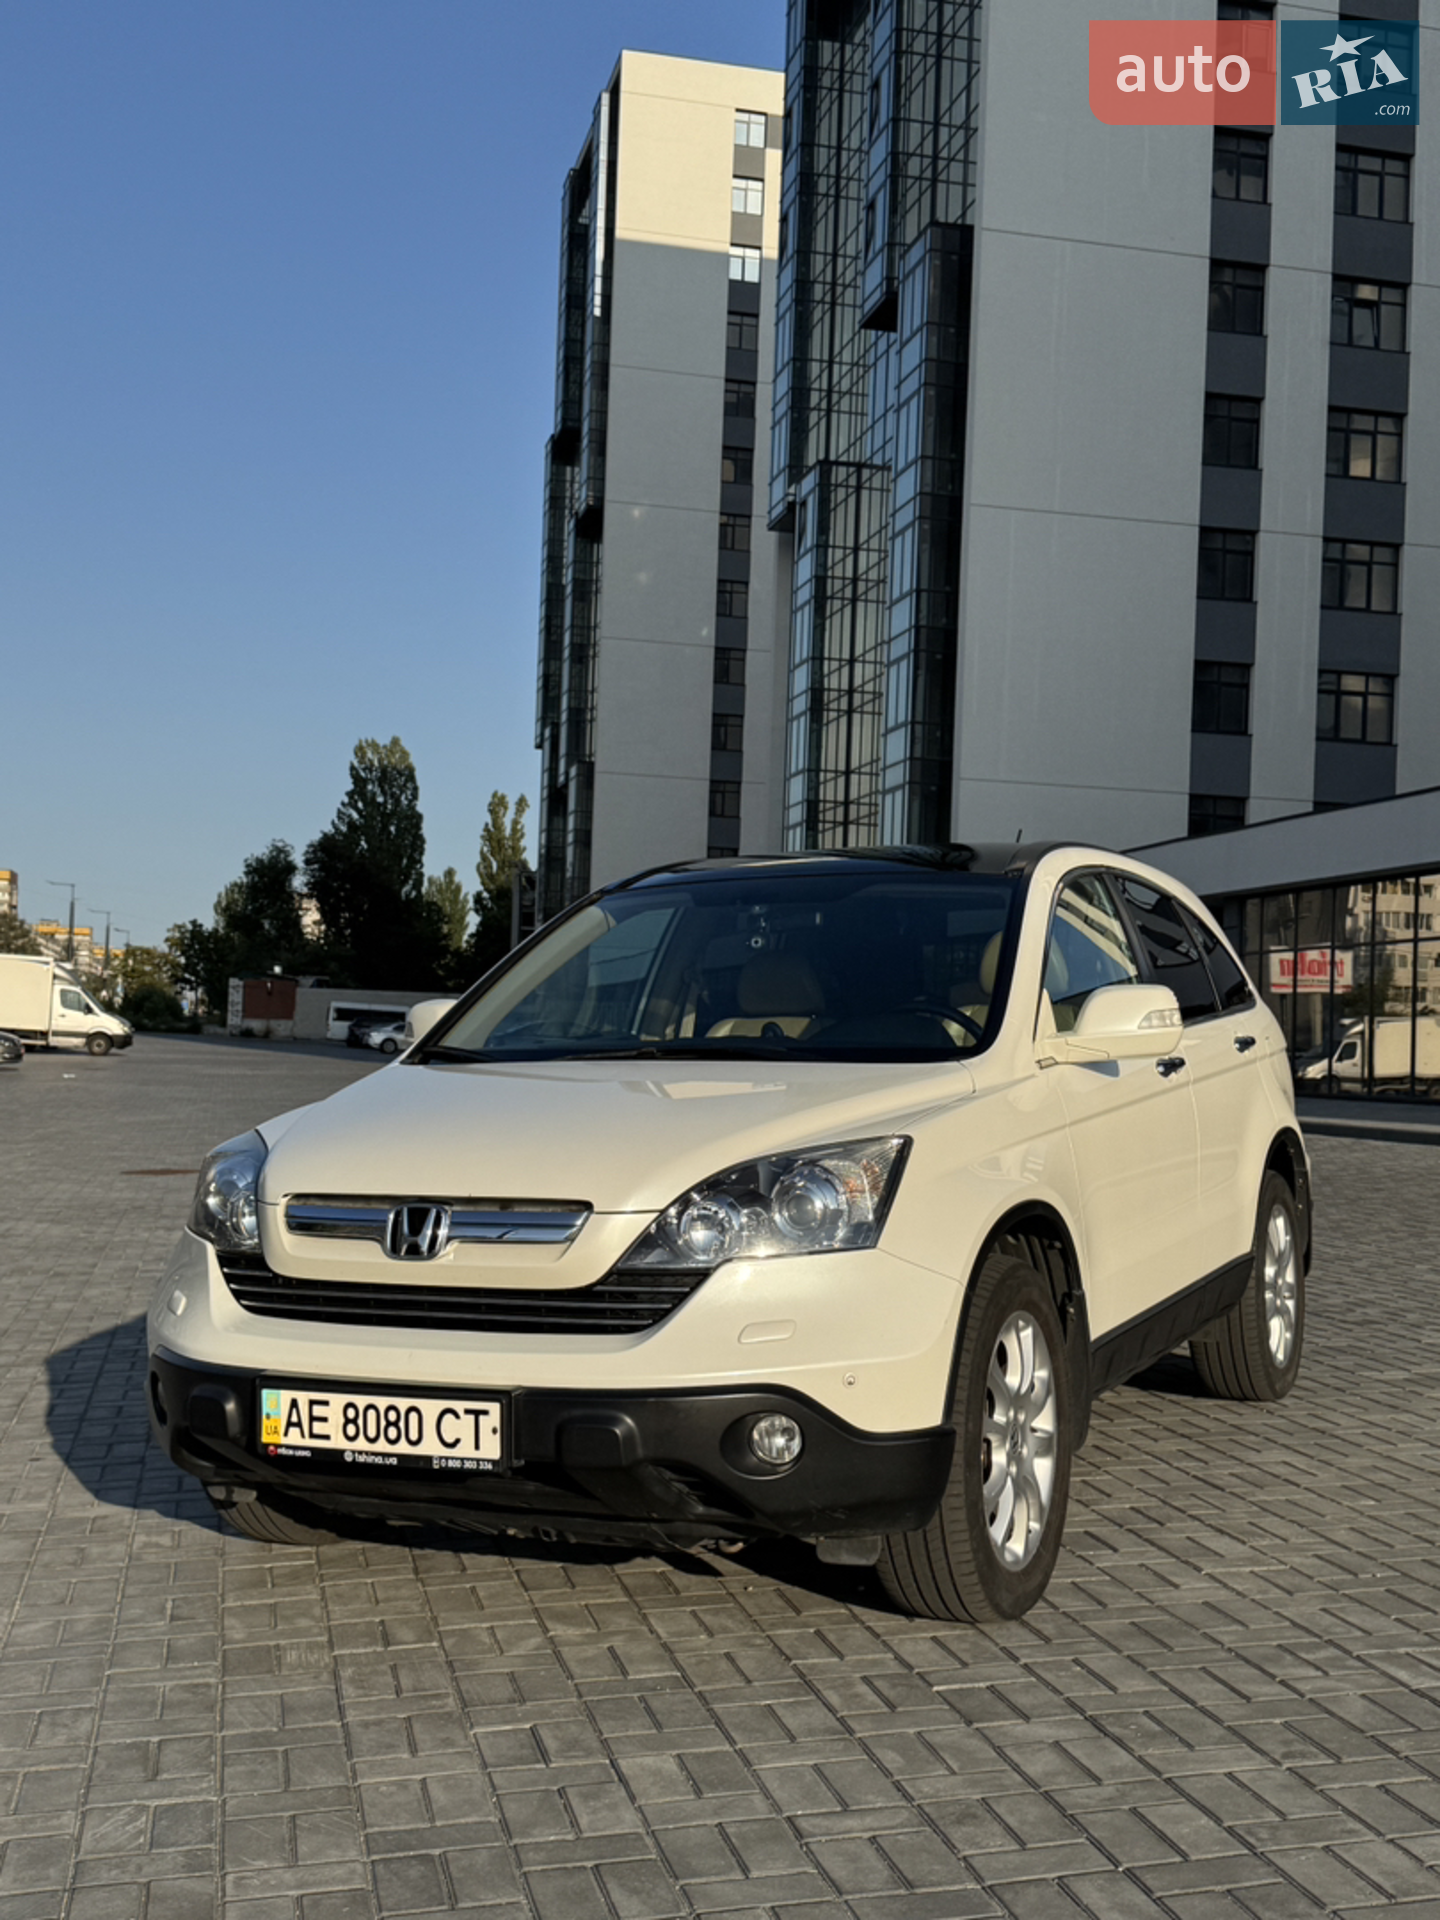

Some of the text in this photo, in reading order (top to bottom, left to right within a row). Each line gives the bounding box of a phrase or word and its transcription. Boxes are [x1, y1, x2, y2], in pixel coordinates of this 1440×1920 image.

[265, 1425, 280, 1437] UA
[283, 1397, 490, 1451] AE 8080 CT
